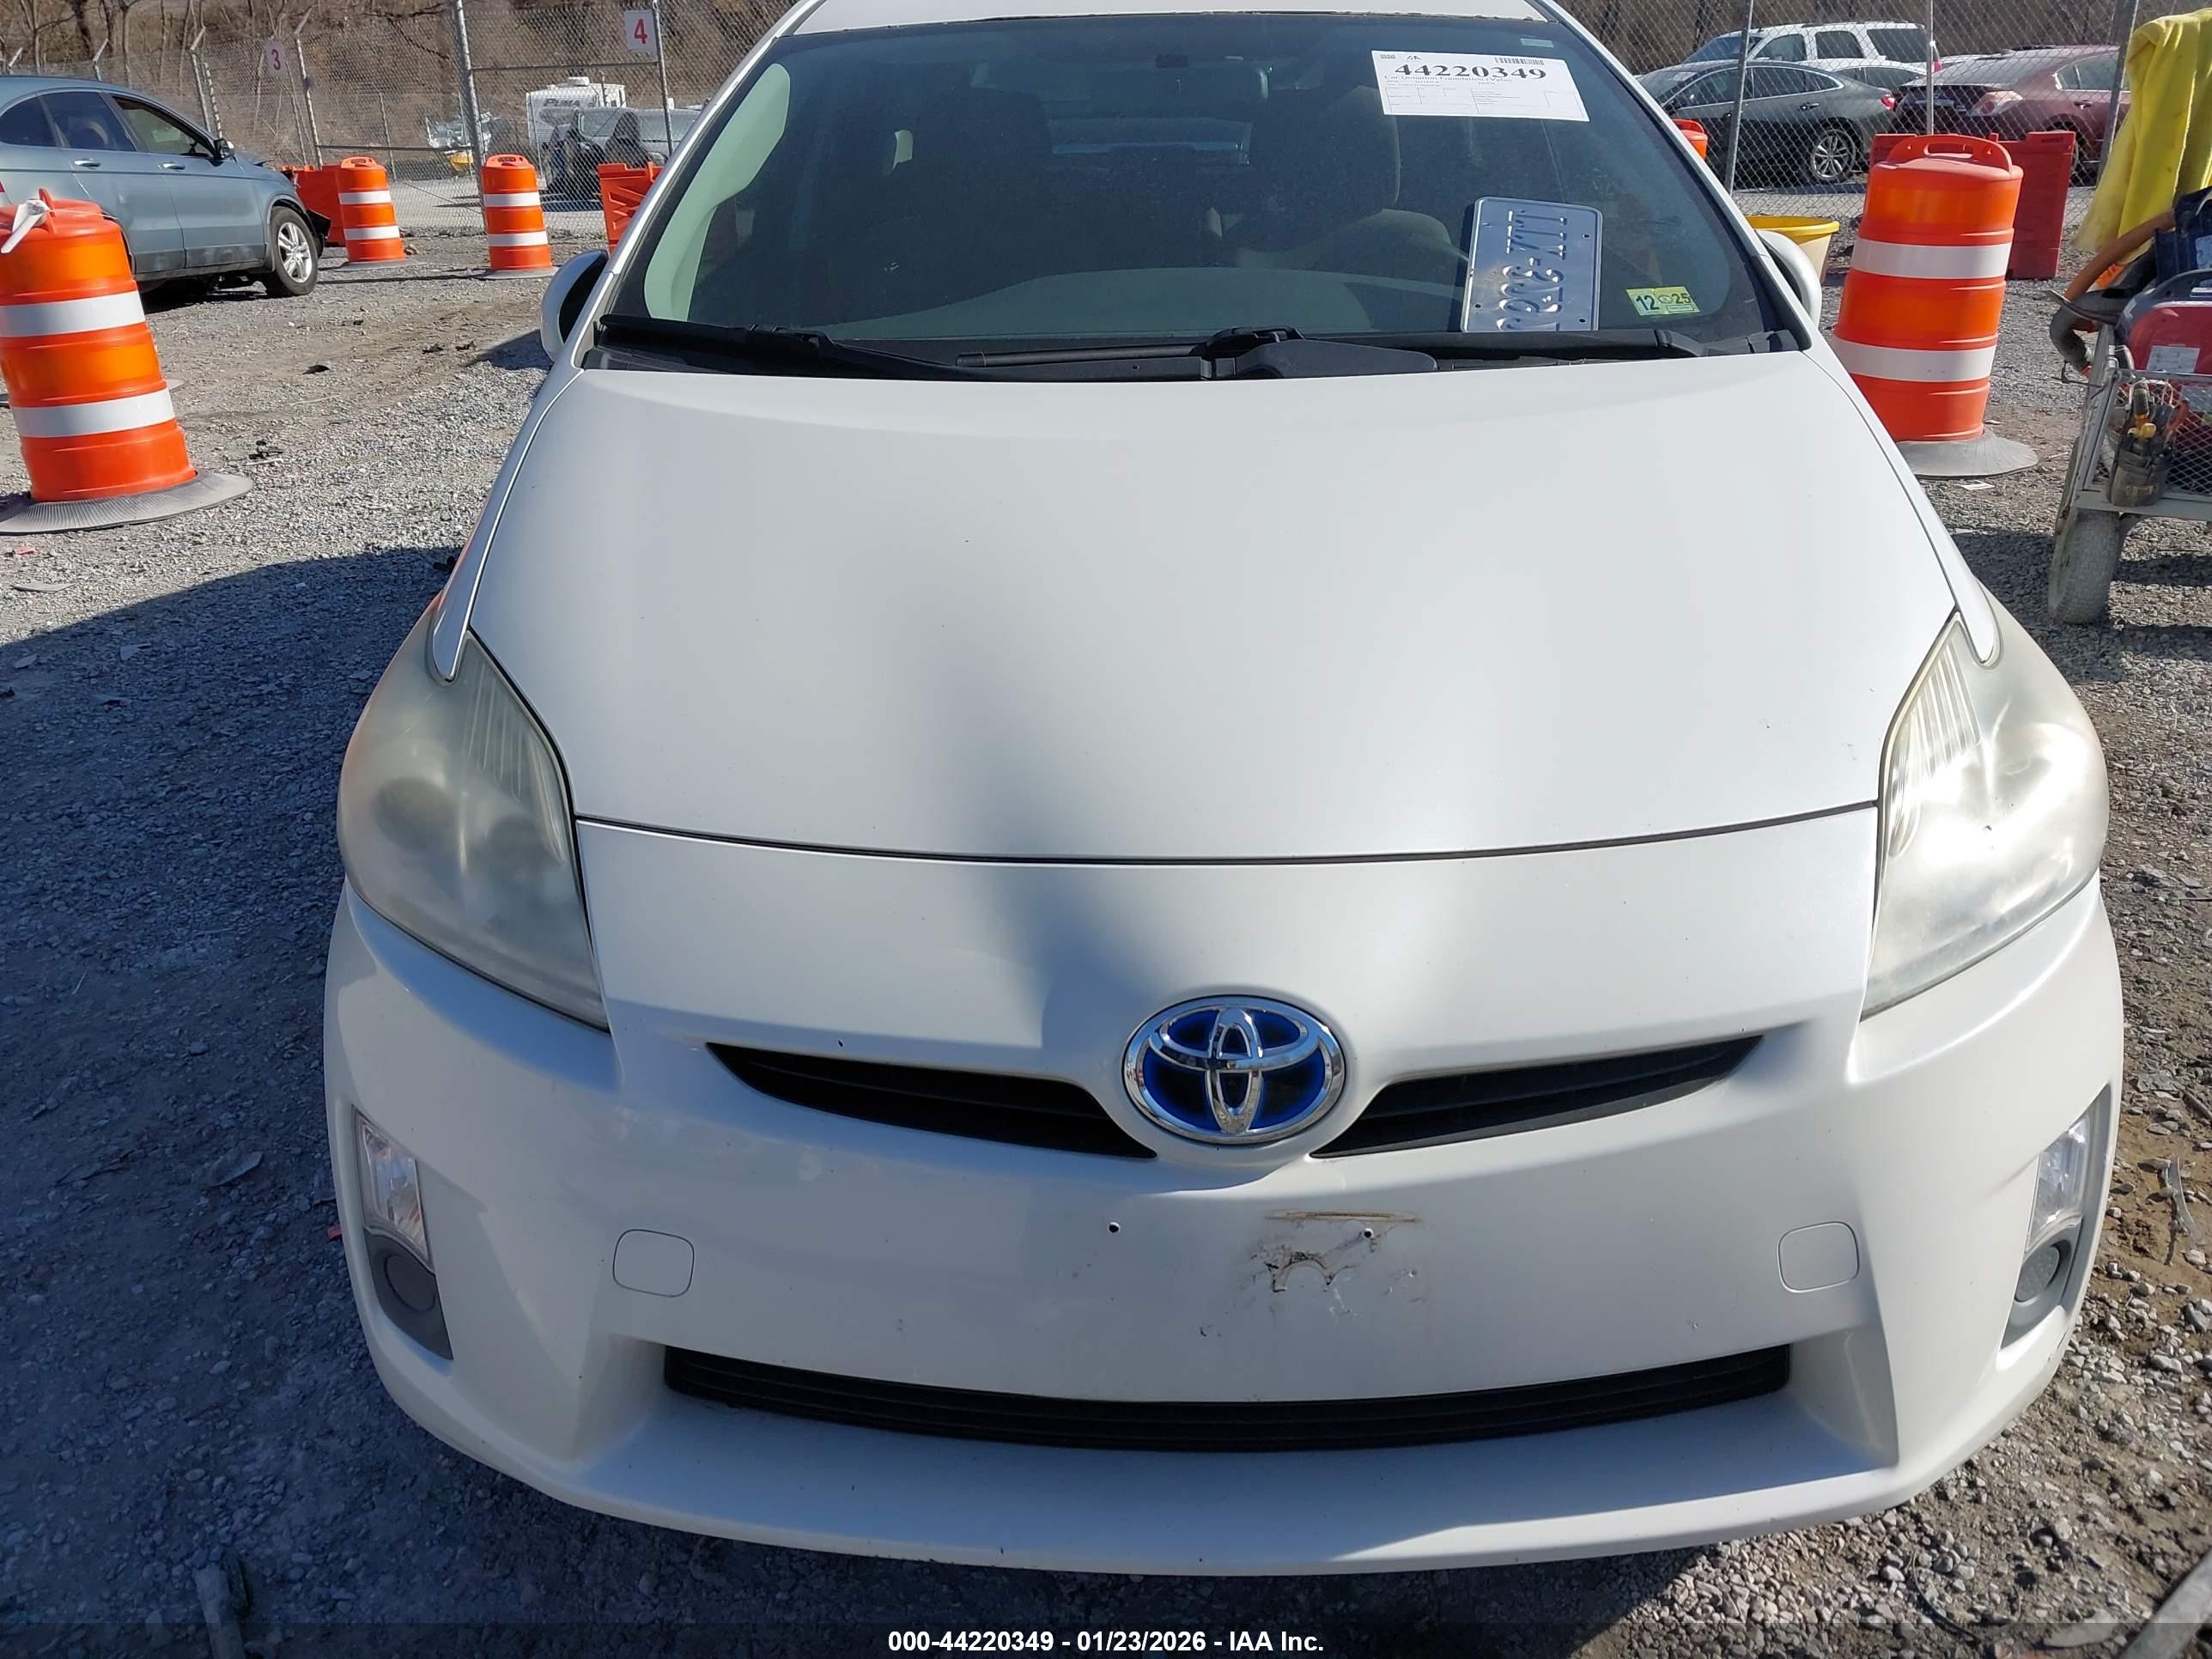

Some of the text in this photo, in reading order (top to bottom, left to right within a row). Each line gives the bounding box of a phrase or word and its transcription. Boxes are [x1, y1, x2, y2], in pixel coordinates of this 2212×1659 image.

[635, 18, 647, 44] 4
[271, 48, 281, 70] 3
[1395, 64, 1547, 80] 44220349
[1635, 295, 1661, 311] 12
[1671, 292, 1692, 304] 25
